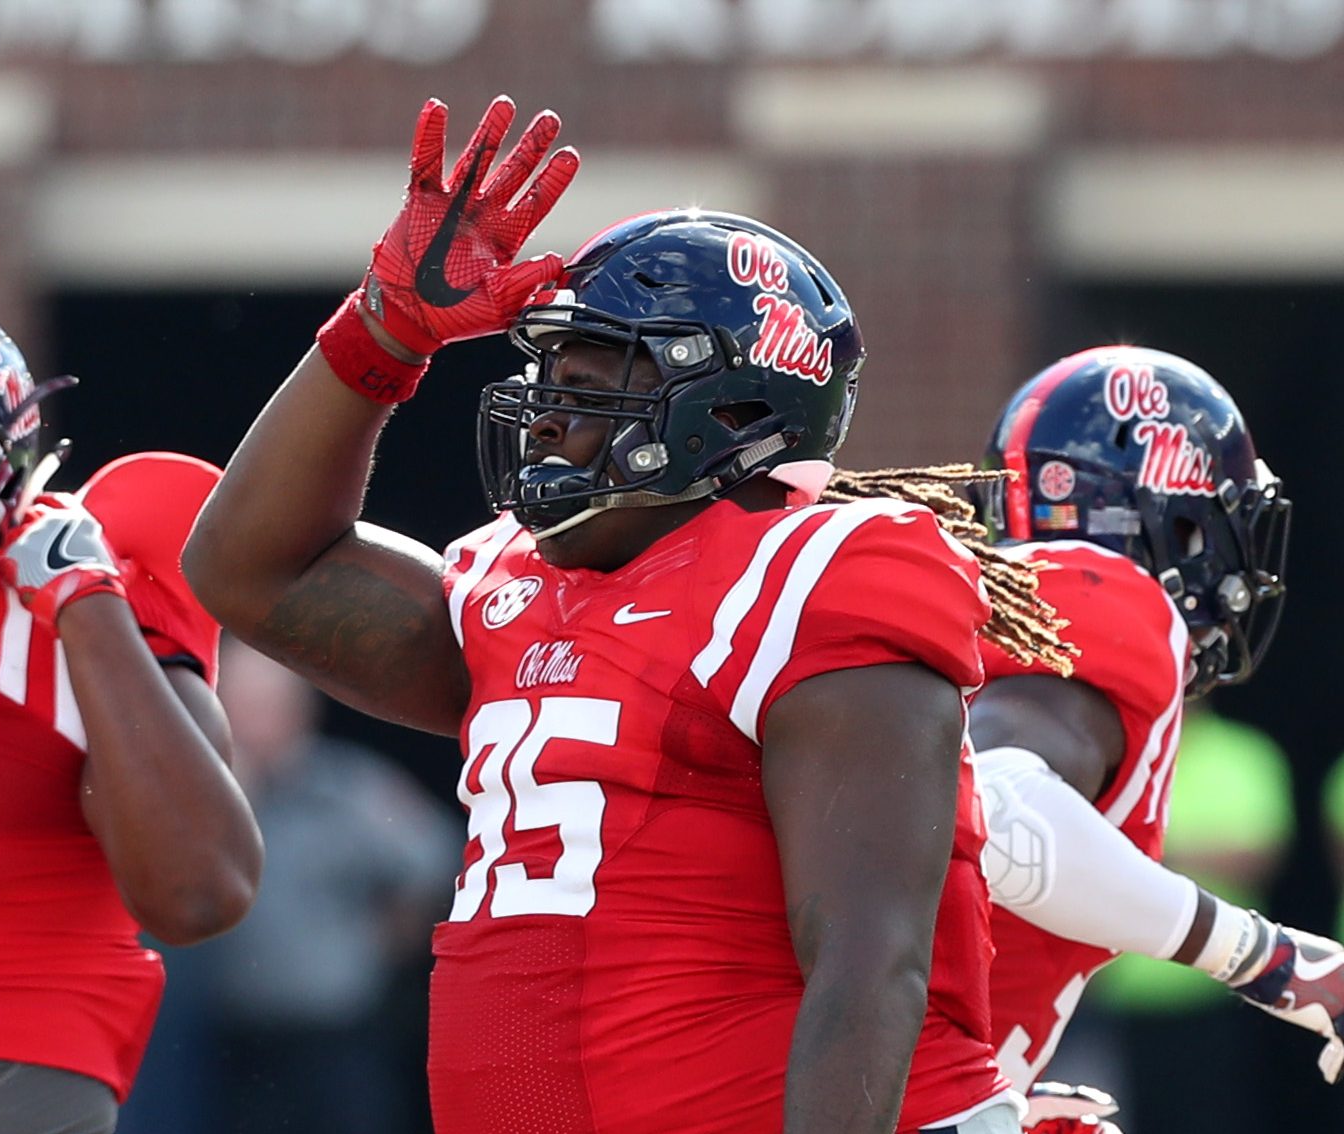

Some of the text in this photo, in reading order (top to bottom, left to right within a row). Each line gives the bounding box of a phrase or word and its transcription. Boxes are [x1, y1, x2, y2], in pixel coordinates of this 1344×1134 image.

[728, 231, 789, 294] Ole
[749, 292, 833, 387] Miss
[1104, 363, 1170, 420] Ole
[486, 580, 538, 624] SEC
[516, 640, 584, 688] Ole Miss
[448, 696, 622, 922] 95
